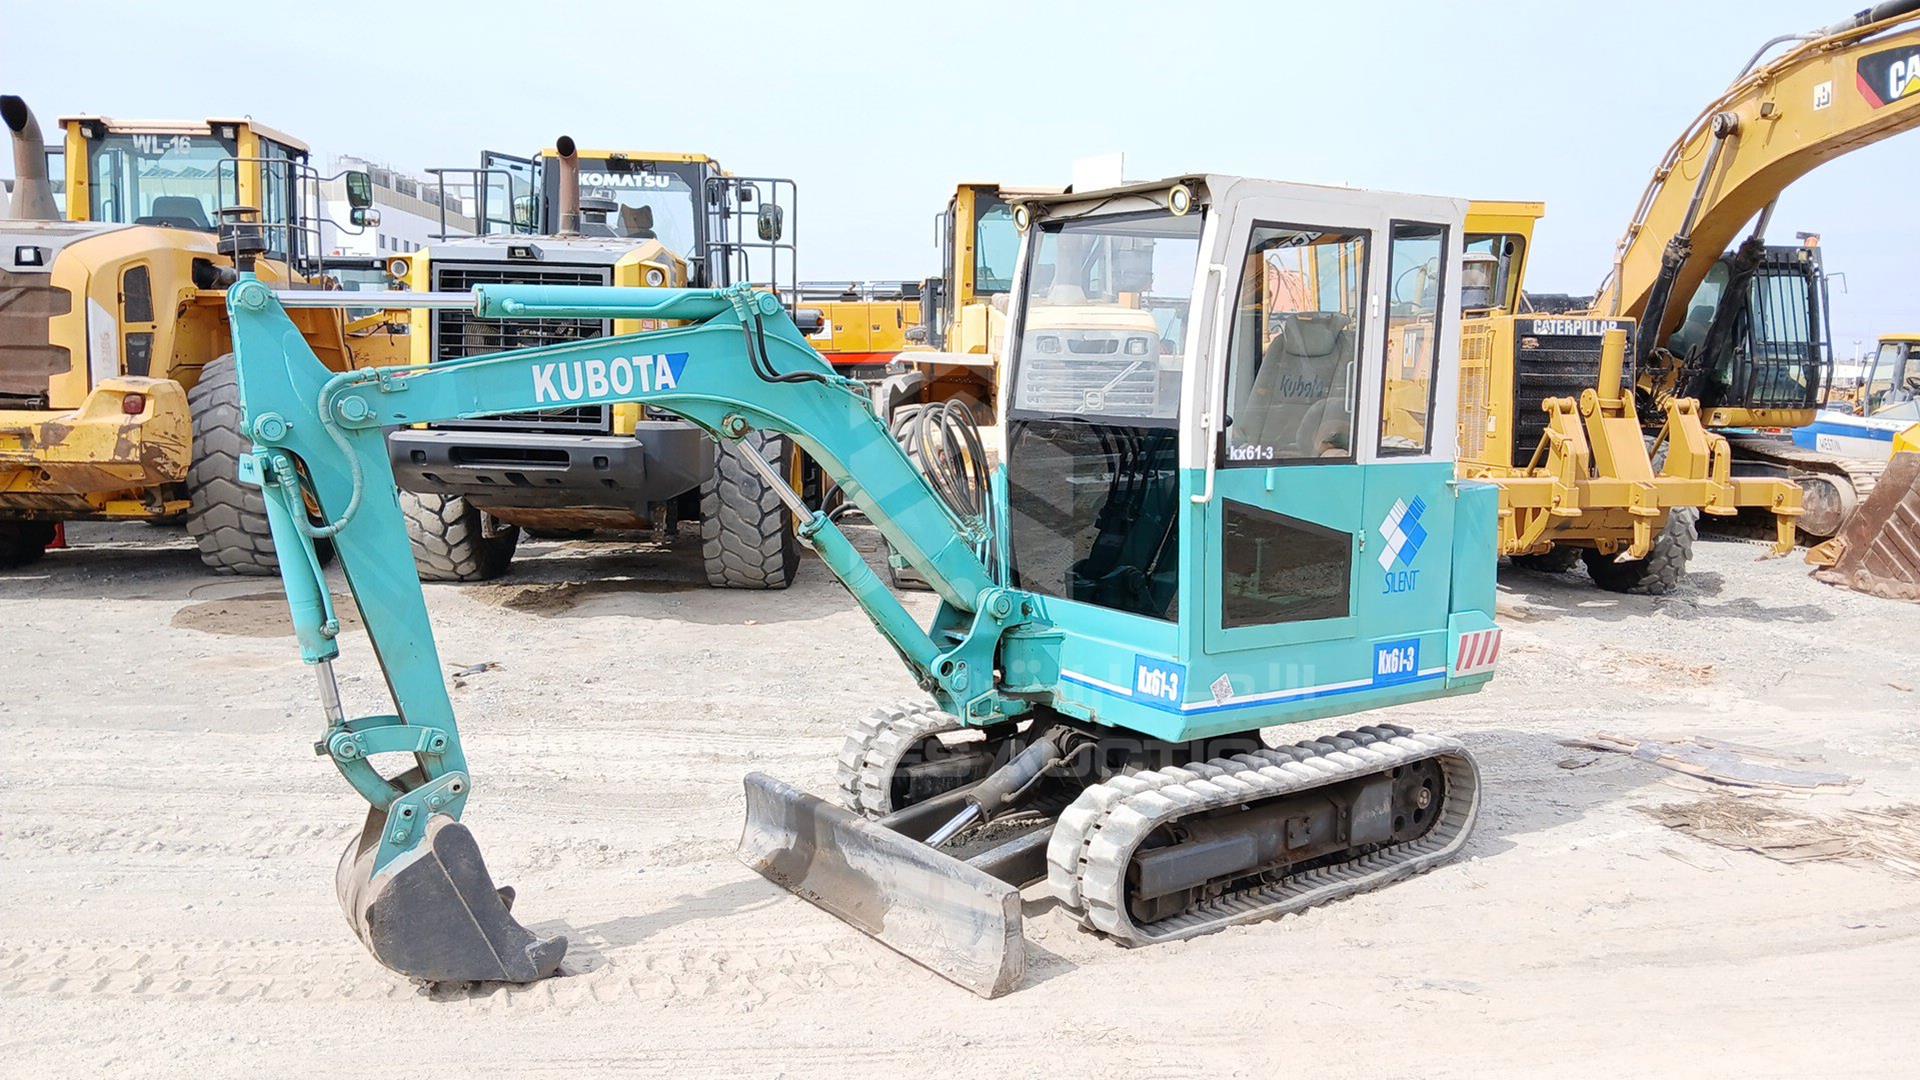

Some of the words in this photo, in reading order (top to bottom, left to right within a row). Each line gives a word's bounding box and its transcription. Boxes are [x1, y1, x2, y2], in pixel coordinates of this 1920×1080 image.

[132, 134, 192, 154] WL-16
[578, 171, 670, 188] KOMATSU
[531, 354, 677, 403] KUBOTA
[1382, 569, 1420, 594] SILENT
